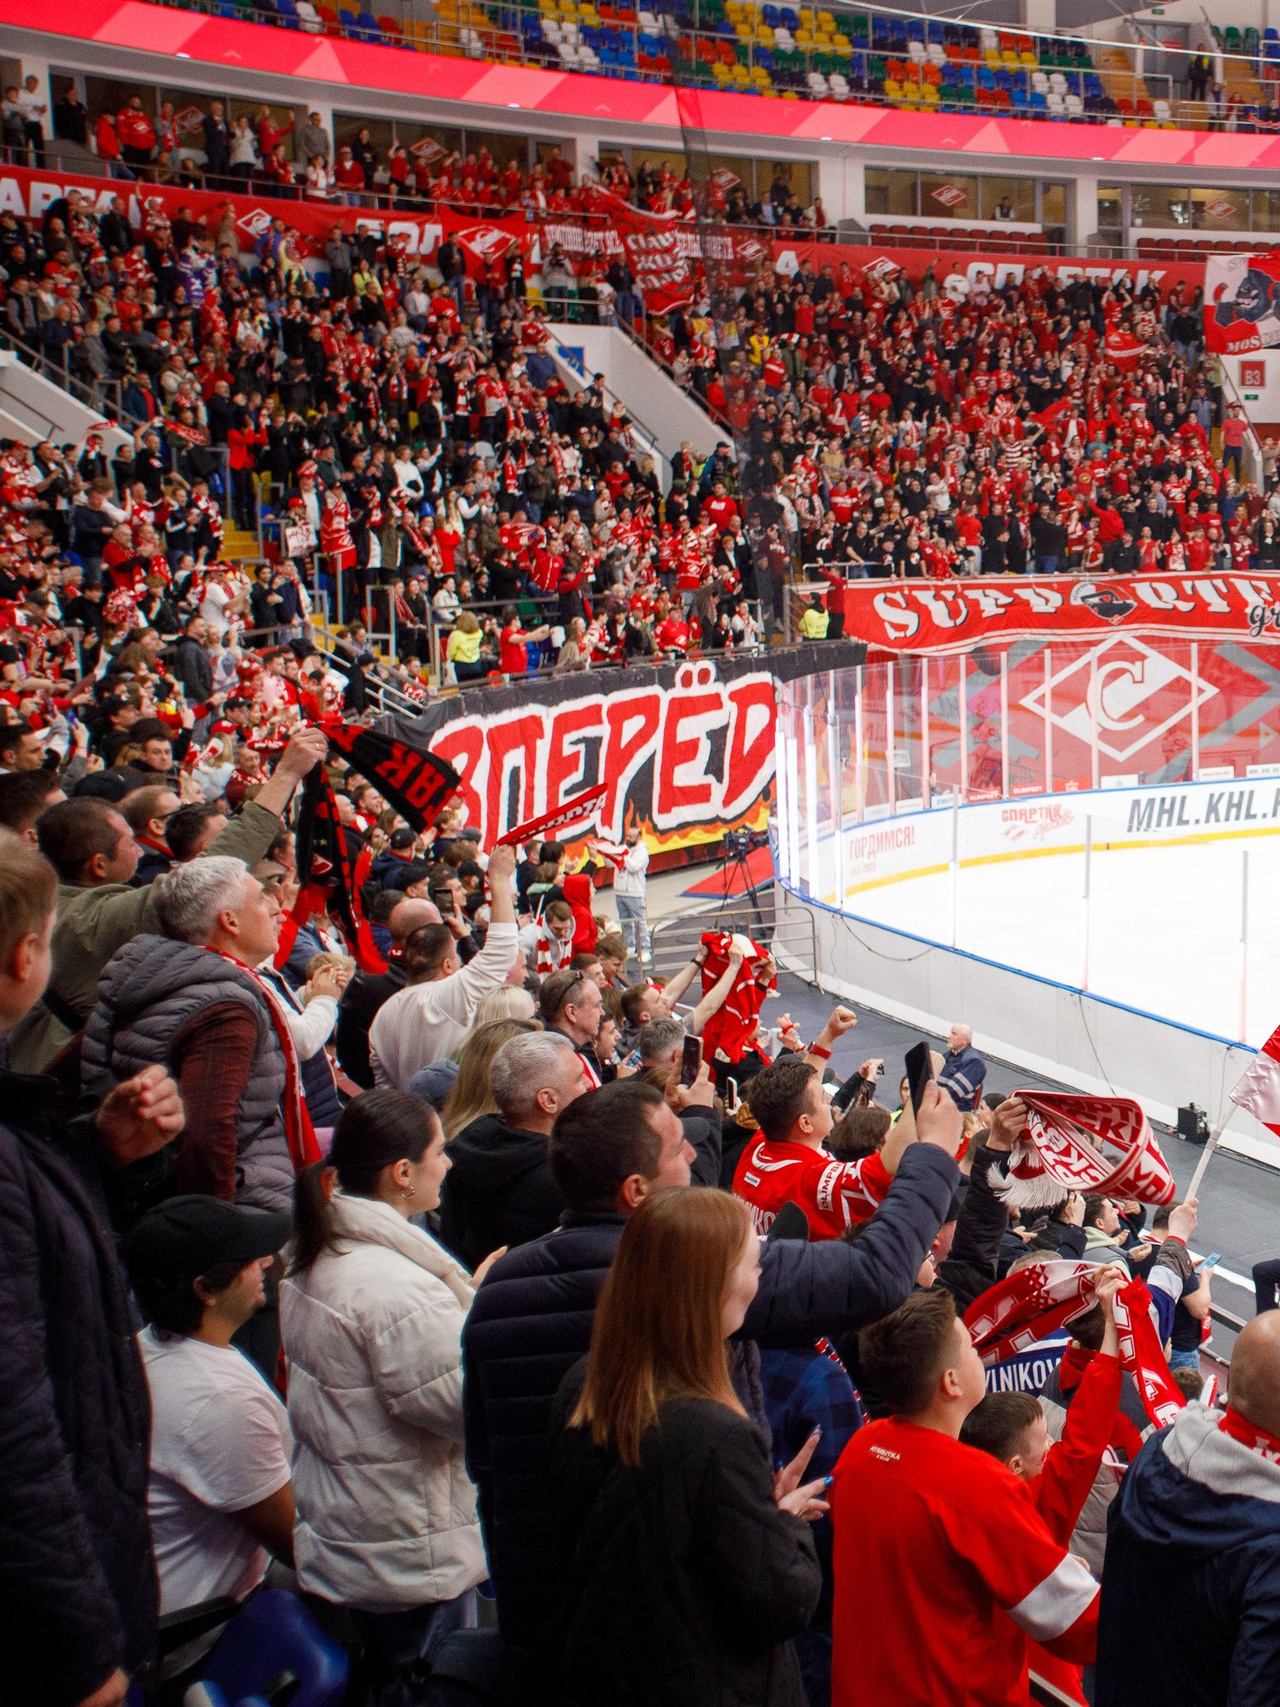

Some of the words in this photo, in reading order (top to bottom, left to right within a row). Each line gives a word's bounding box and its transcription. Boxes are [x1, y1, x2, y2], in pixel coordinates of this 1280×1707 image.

[966, 261, 1168, 298] СПРТАК
[1001, 803, 1062, 824] СПАРТАК
[849, 824, 915, 861] ГОРДИМСЯ!
